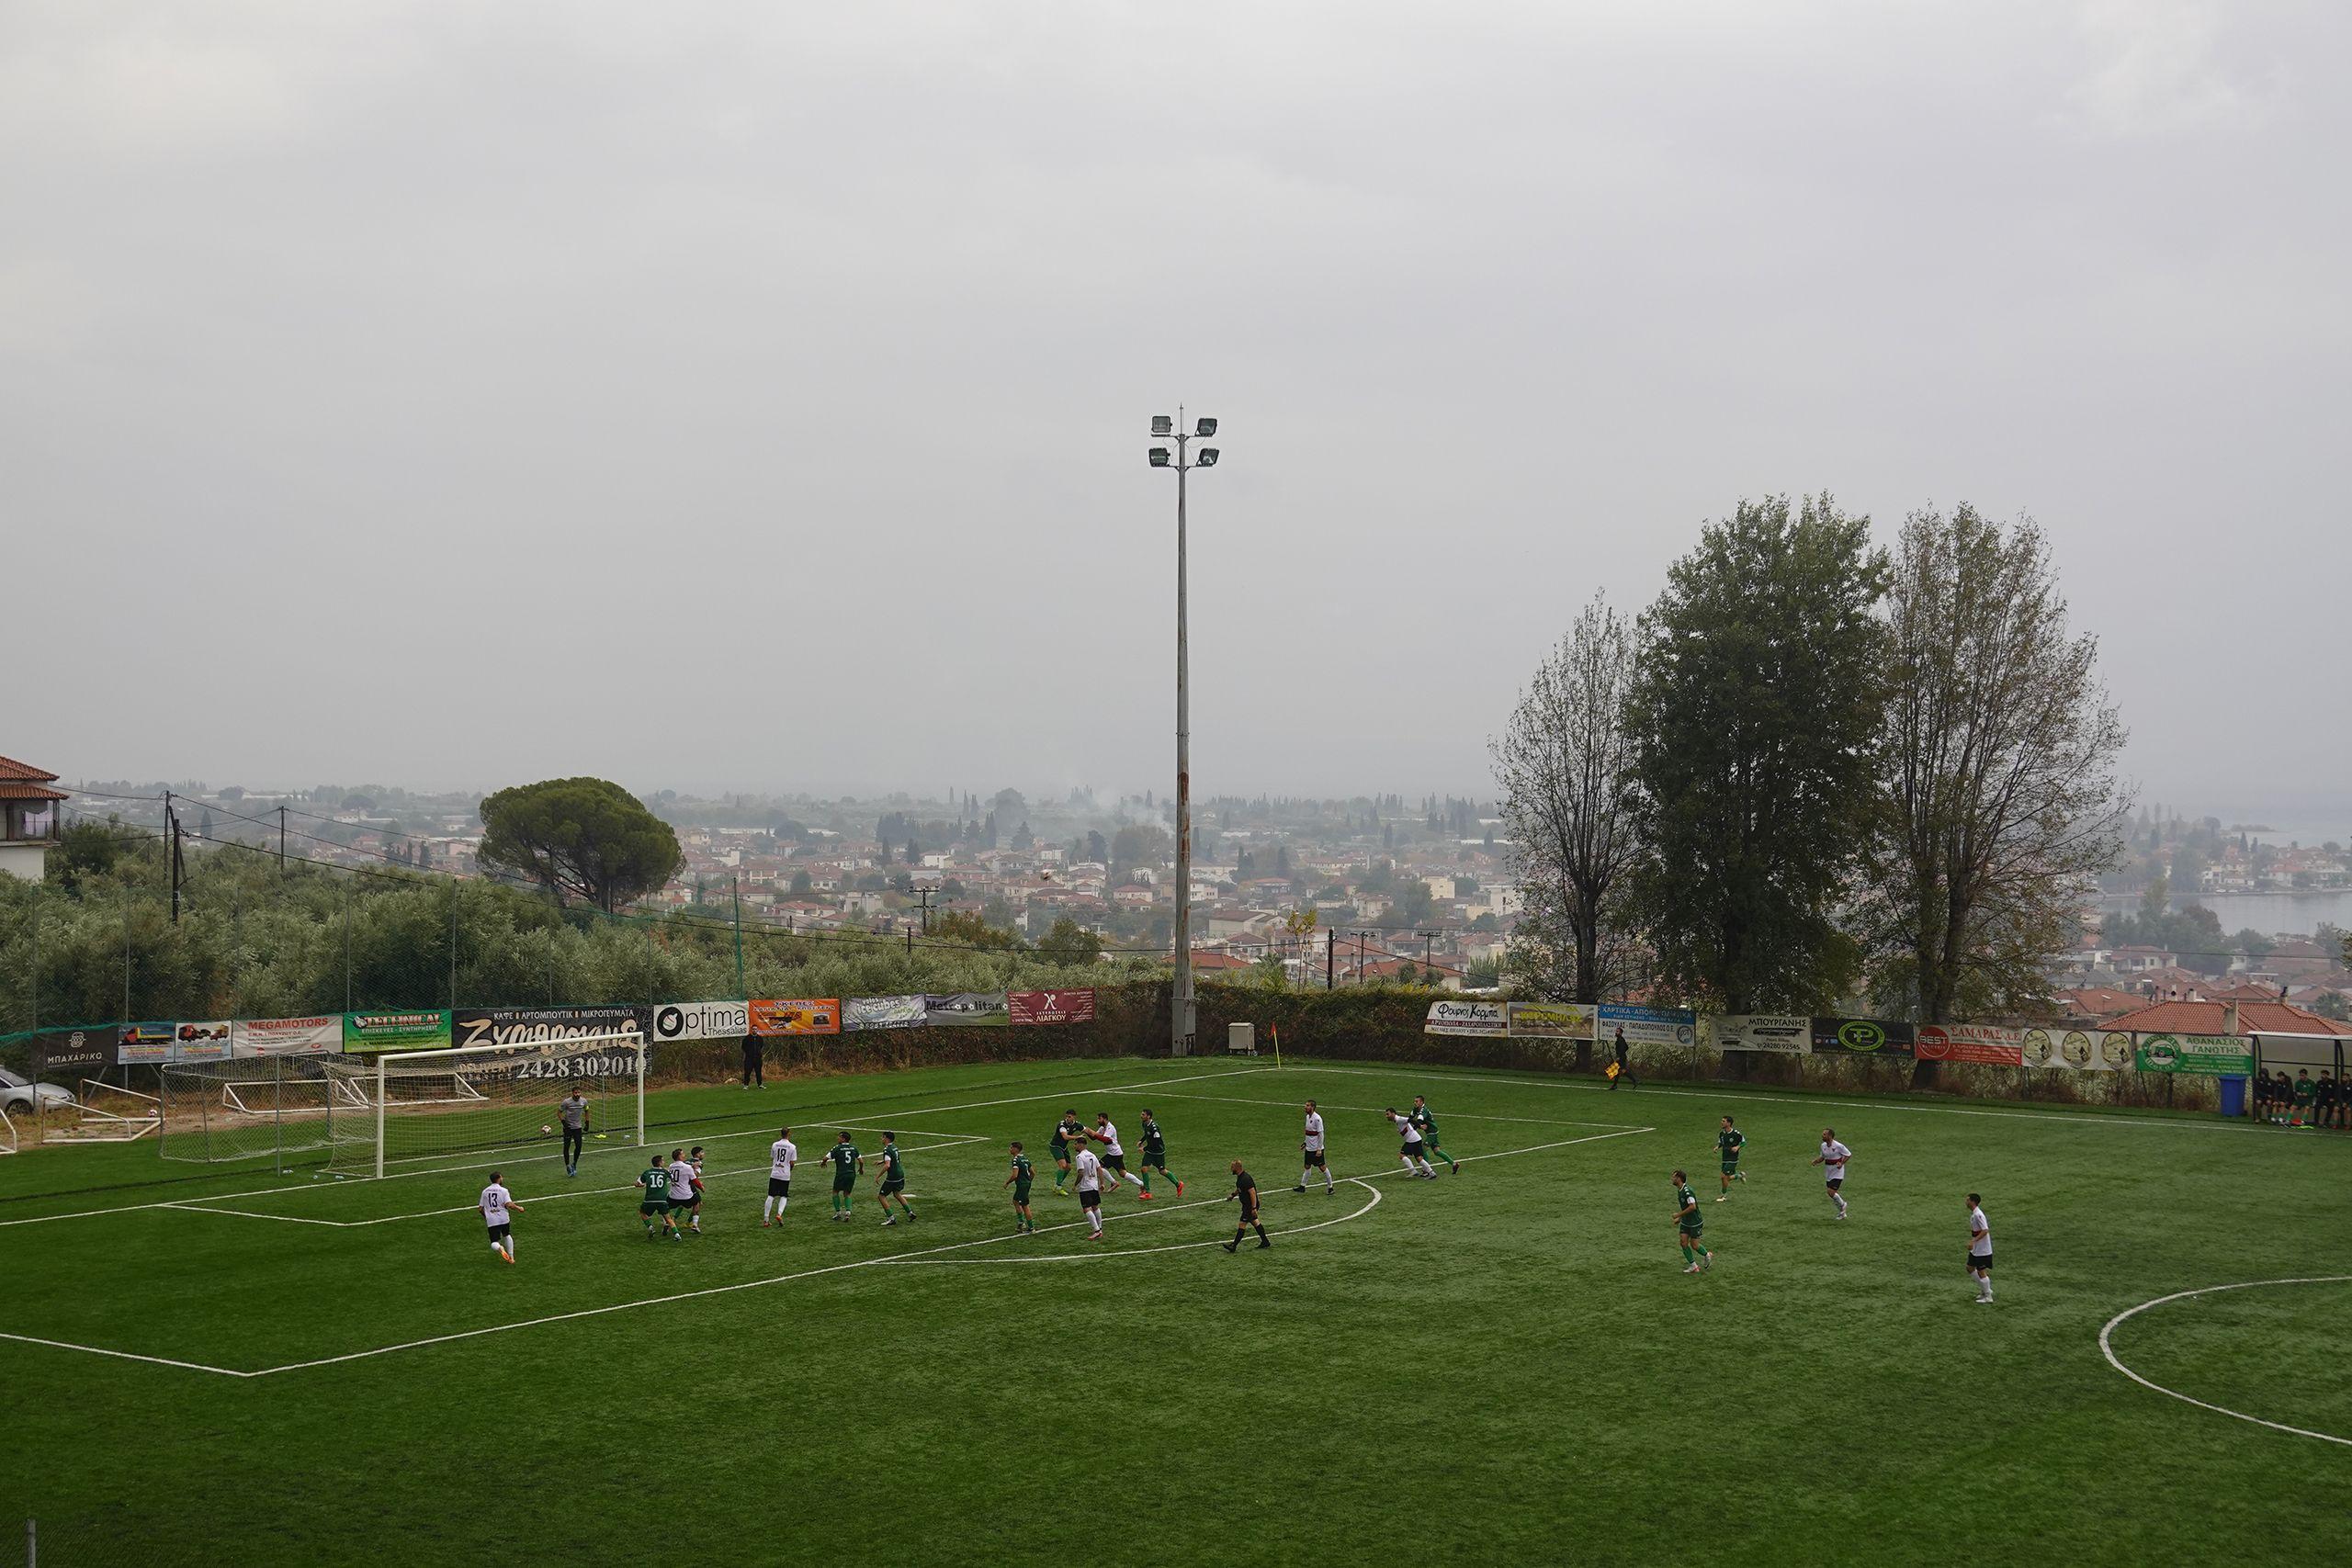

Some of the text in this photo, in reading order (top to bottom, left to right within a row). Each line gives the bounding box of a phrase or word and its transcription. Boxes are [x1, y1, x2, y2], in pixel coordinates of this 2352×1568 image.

[872, 998, 900, 1012] cubes
[1602, 1006, 1631, 1014] ΧΑΡΤΙΚΑ
[364, 1013, 442, 1027] TECHNICAL
[581, 1010, 634, 1018] ΜΙΚΡΟΓΕΥΜΑΤΑ
[248, 1017, 328, 1030] MEGAMOTORS
[657, 1006, 747, 1037] Optima
[1748, 1018, 1807, 1027] ΜΠΟΥΡΓΑΝΗΣ
[707, 1026, 747, 1035] Thessalias
[1951, 1026, 2002, 1040] ΣΑΜΑΡΑΣ
[1919, 1035, 1948, 1044] BEST
[2187, 1037, 2245, 1046] ΑΘΑΝΑΣΙΟΣ
[516, 1057, 570, 1078] 2428
[777, 1148, 786, 1163] 18
[844, 1151, 852, 1164] 5
[650, 1175, 664, 1188] 16
[488, 1193, 498, 1207] 13
